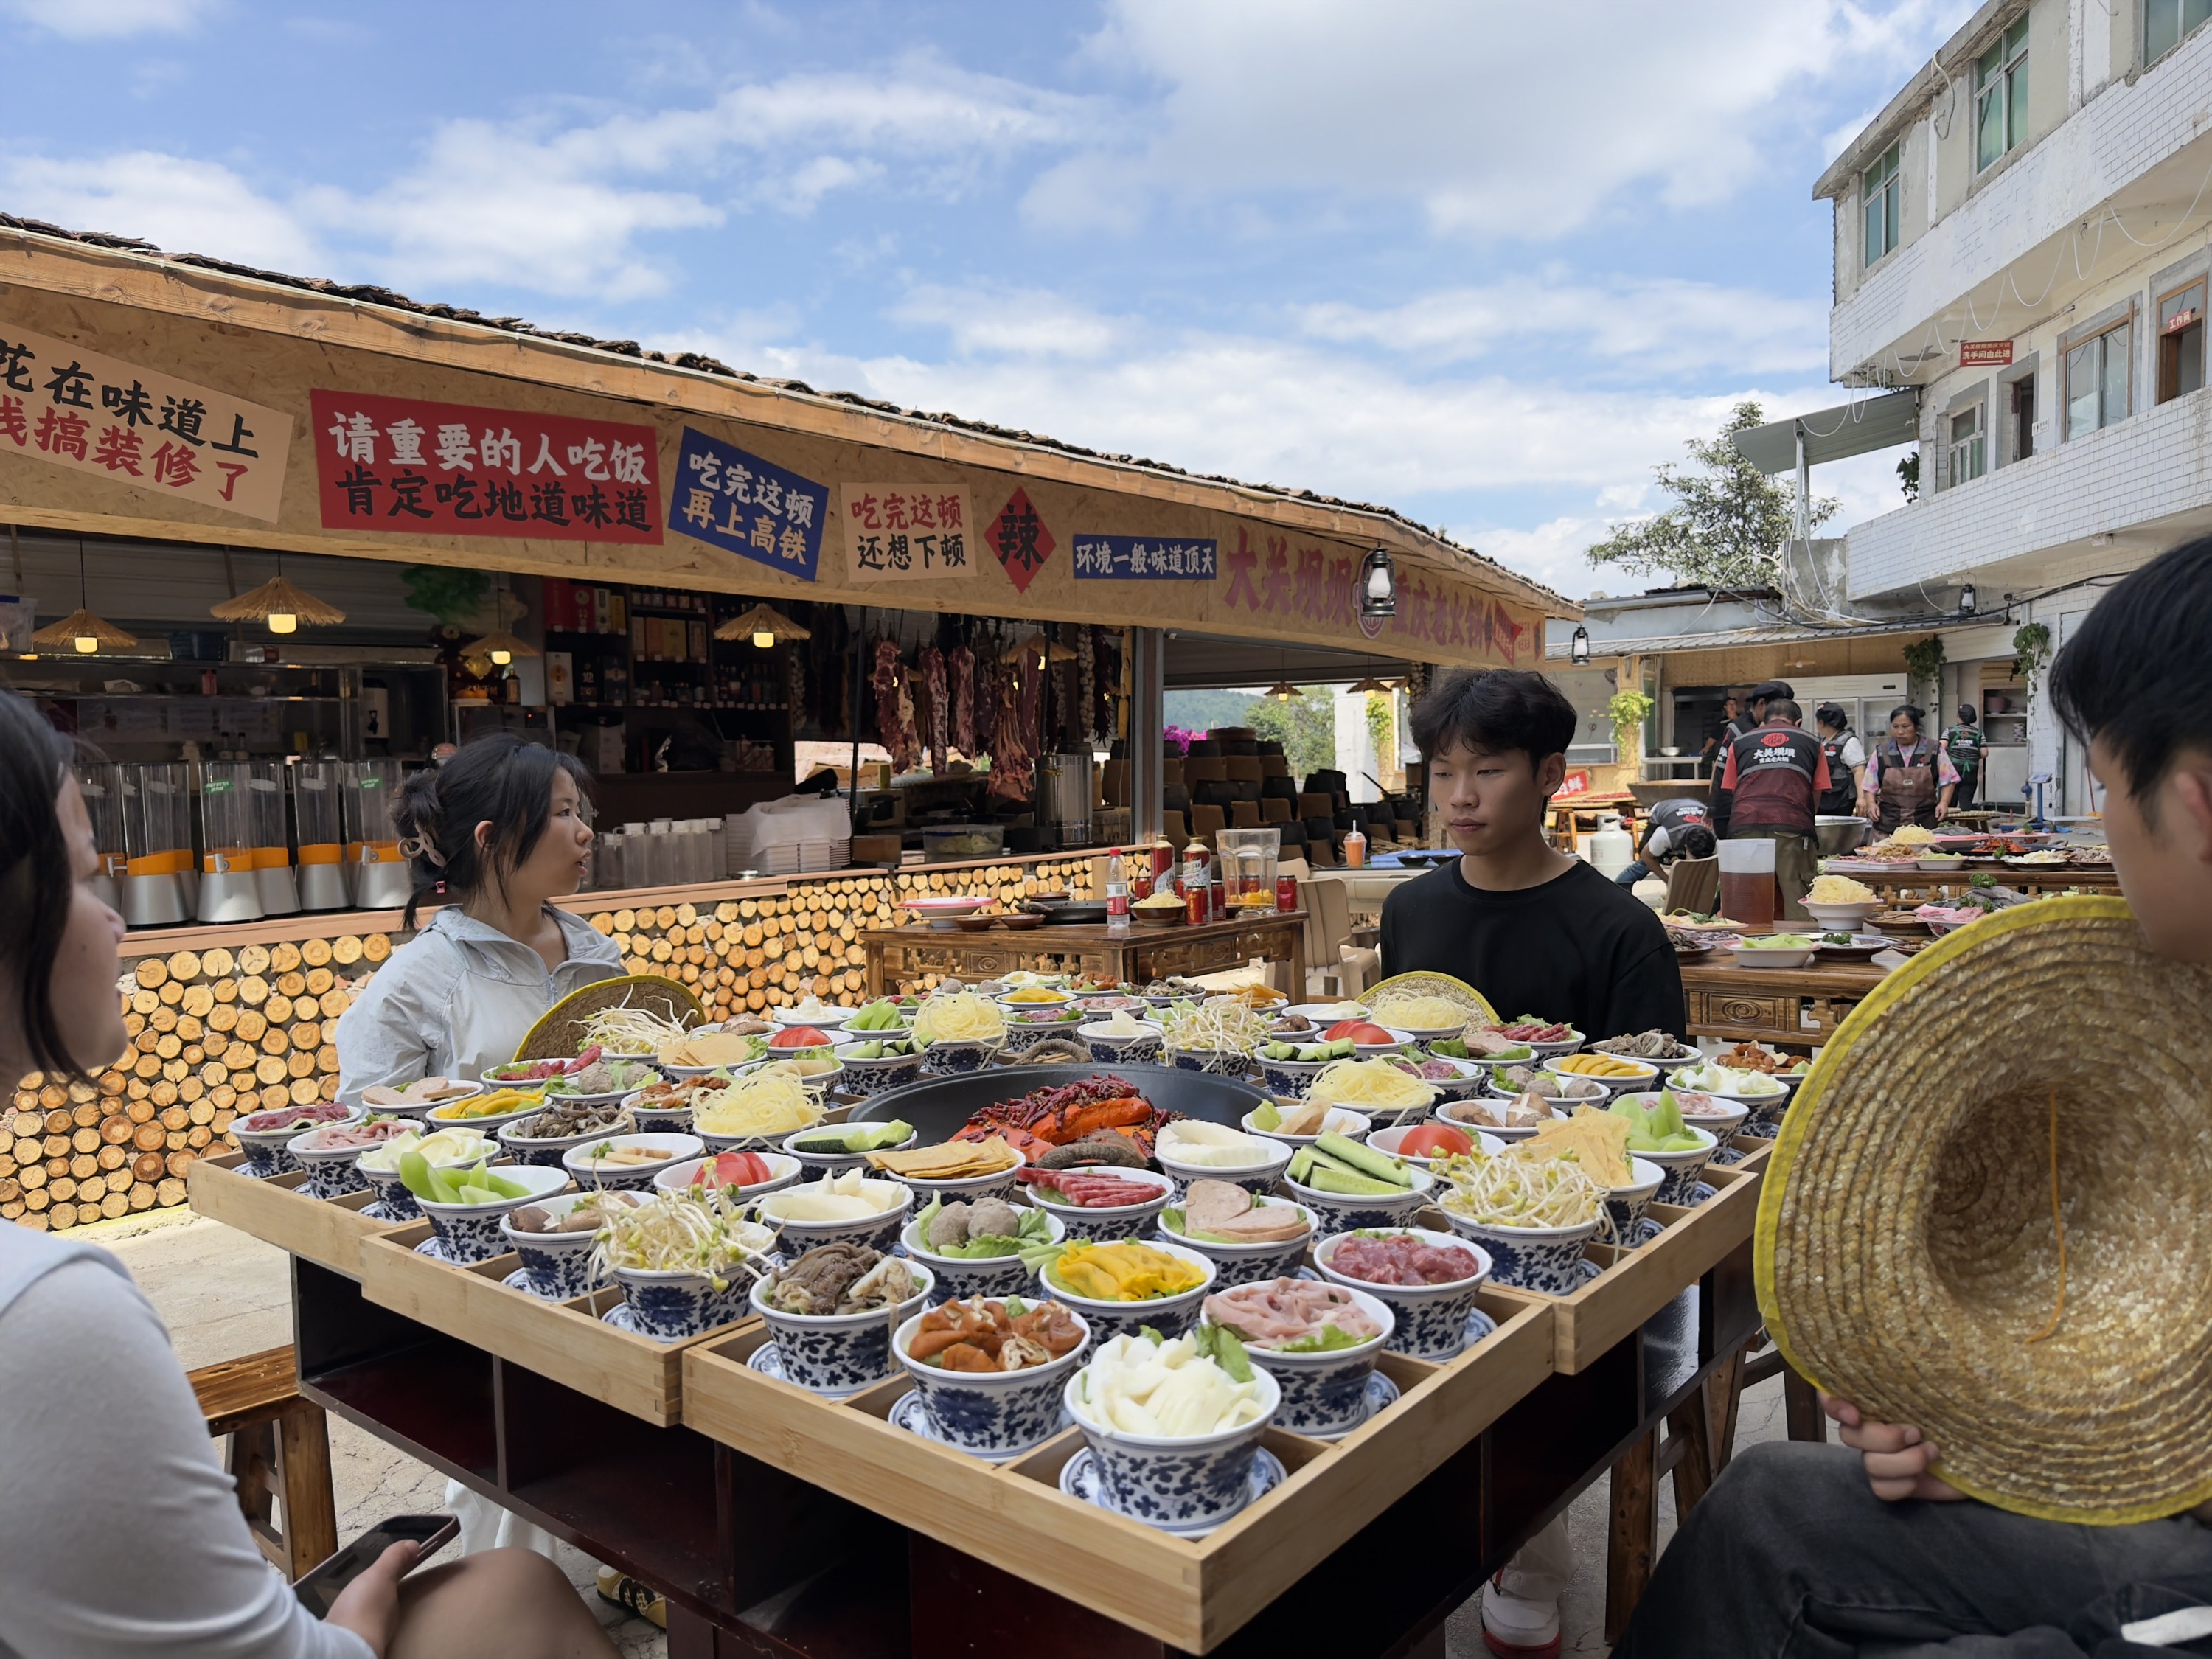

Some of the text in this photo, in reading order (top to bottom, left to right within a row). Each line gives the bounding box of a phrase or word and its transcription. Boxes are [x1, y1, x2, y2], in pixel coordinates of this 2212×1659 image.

[1962, 349, 2011, 360] 洗手间由此进
[0, 339, 259, 459] 花在味道上
[328, 411, 652, 485] 请重要的人吃饭
[335, 464, 653, 532] 肯定吃地道味道
[689, 451, 815, 529] 吃完这顿
[851, 493, 964, 530] 吃完这顿
[682, 487, 807, 566] 再上高铁
[857, 533, 967, 570] 还想下顿
[998, 503, 1044, 571] 辣
